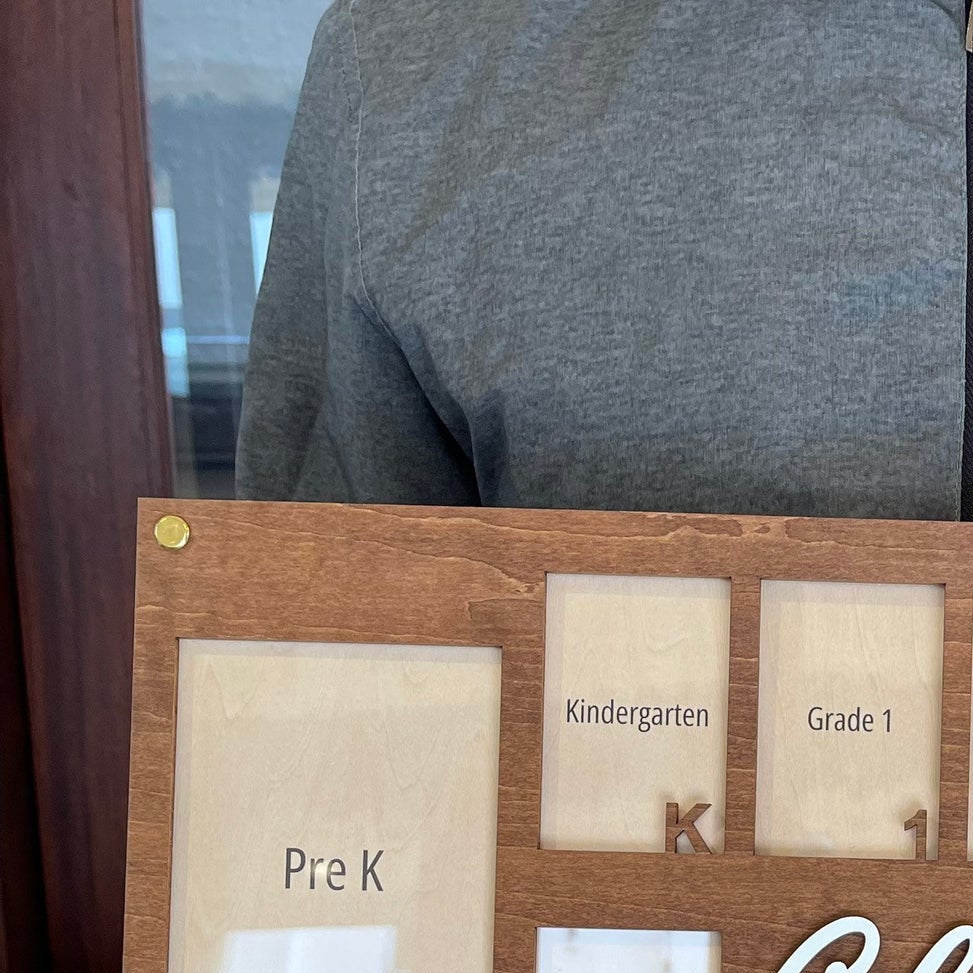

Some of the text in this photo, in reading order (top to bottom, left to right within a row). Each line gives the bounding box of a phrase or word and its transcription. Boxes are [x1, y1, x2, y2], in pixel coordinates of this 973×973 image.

[565, 699, 709, 733] Kindergarten
[808, 706, 892, 733] Grade 1
[665, 802, 712, 854] K
[904, 809, 928, 860] 1
[284, 847, 384, 891] Pre K
